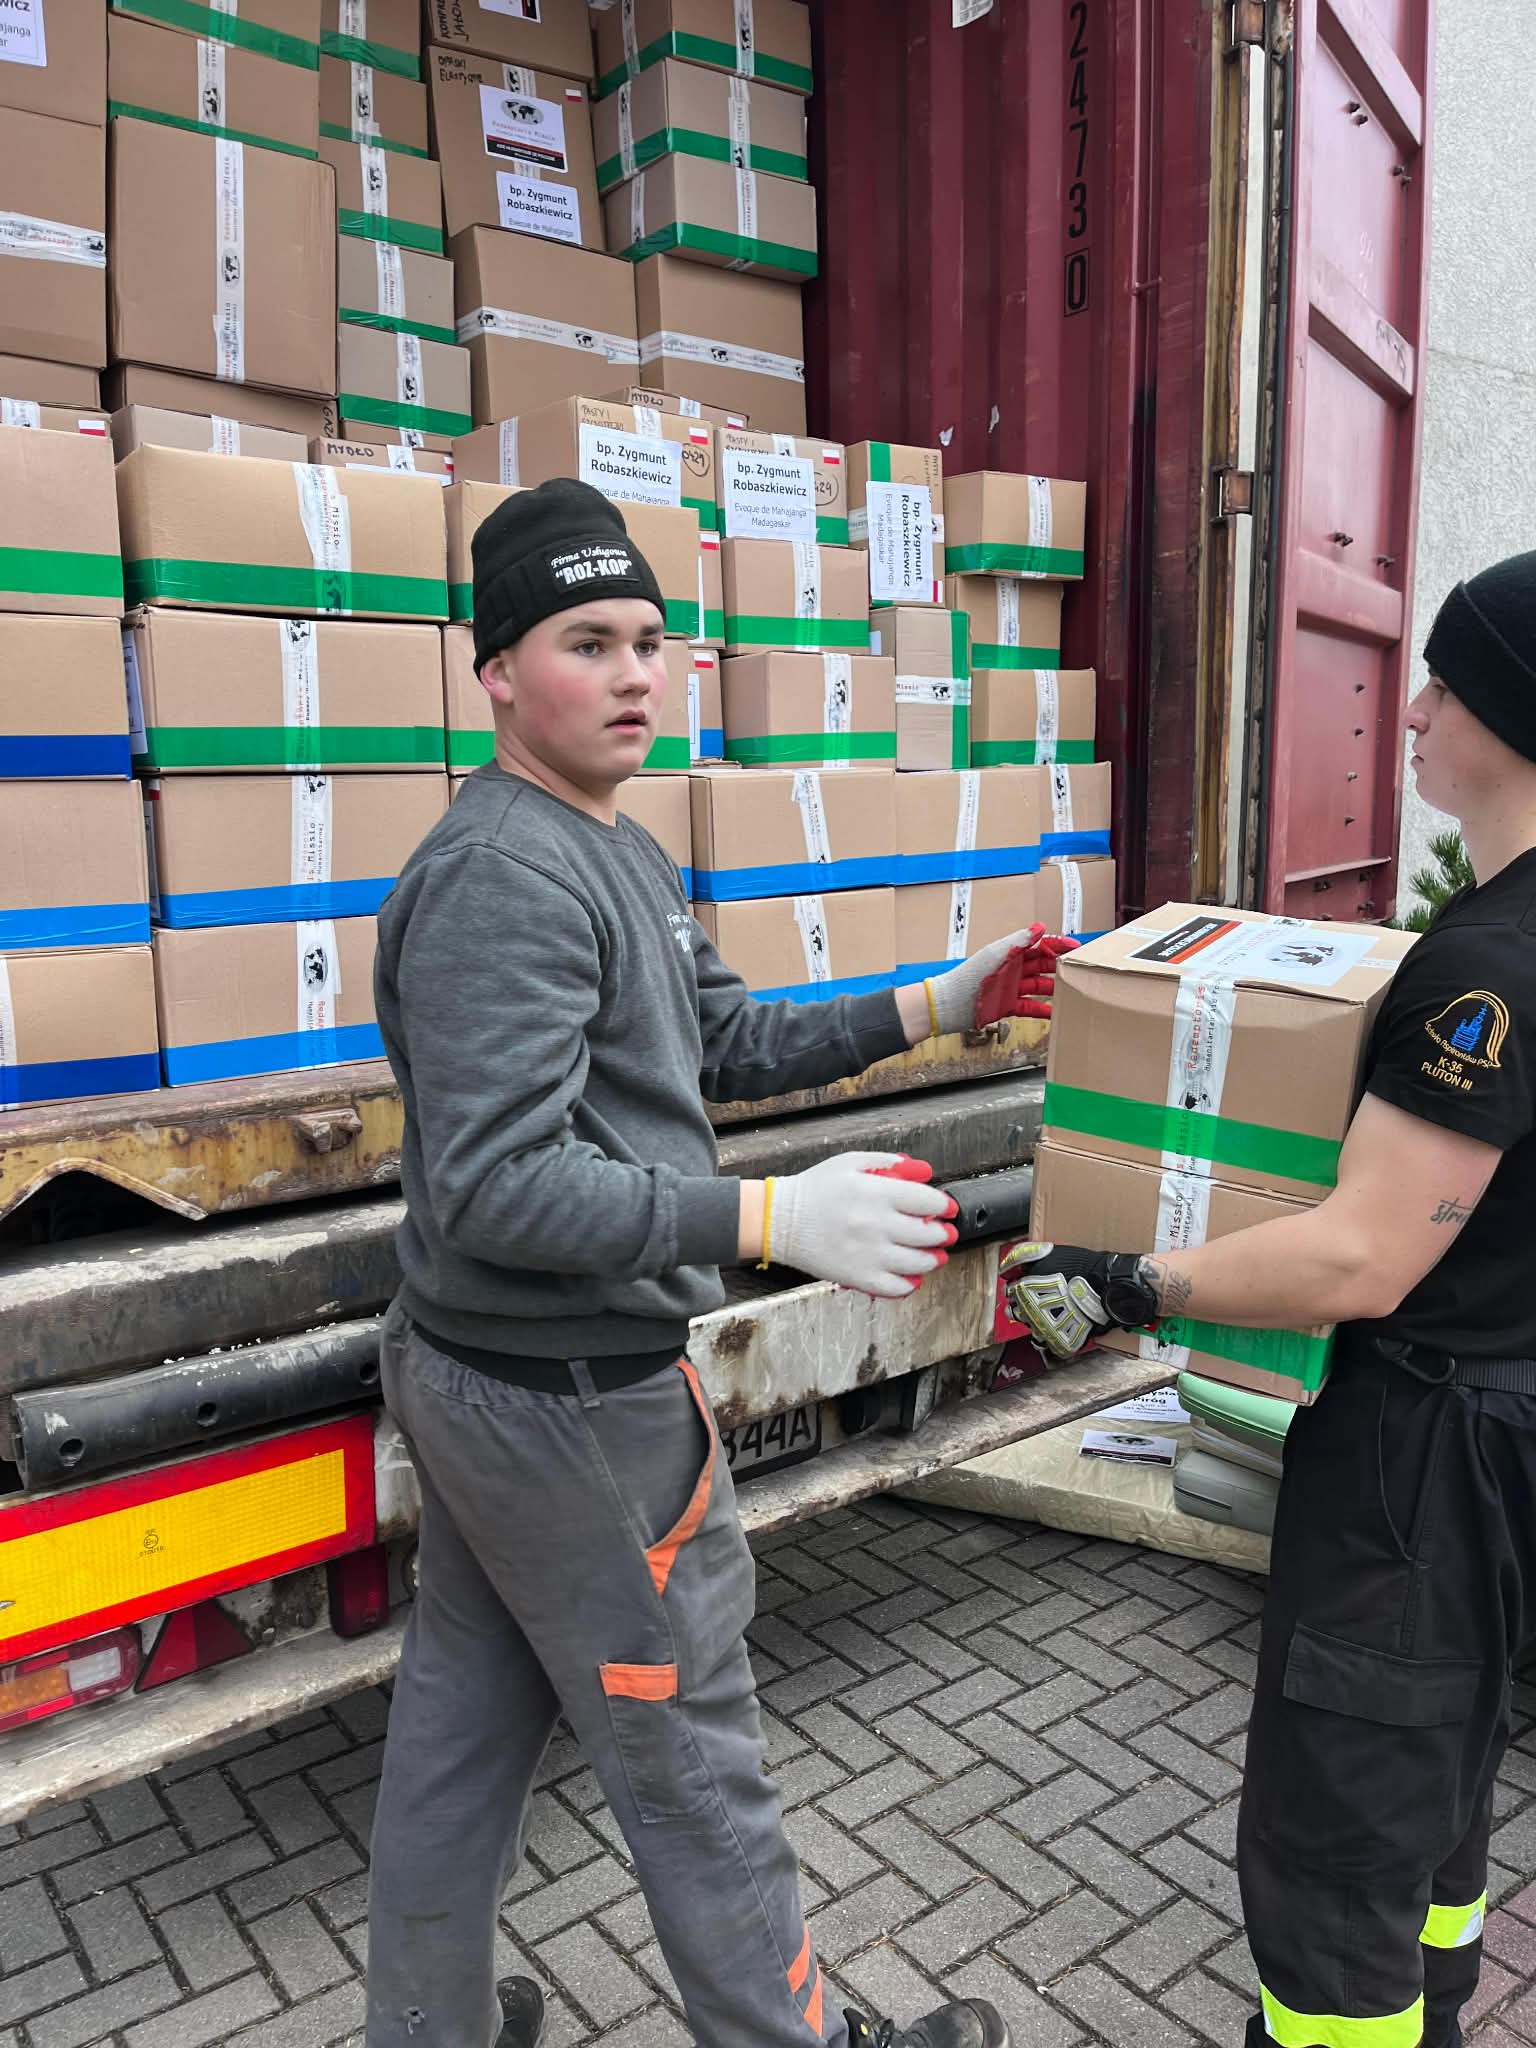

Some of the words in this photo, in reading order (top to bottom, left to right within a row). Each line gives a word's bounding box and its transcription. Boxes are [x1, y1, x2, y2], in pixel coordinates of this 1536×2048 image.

[509, 184, 526, 197] bp.
[527, 188, 567, 206] Zygmunt
[507, 198, 573, 220] Robaszkiewicz
[597, 441, 615, 457] bp.
[618, 445, 668, 466] Zygmunt
[591, 458, 672, 486] Robaszkiewicz
[737, 461, 754, 475] bp.
[756, 464, 801, 480] Zygmunt
[733, 479, 807, 497] Robaszkiewicz
[761, 504, 771, 514] de
[912, 501, 921, 521] bp.
[331, 506, 341, 546] Missio
[901, 494, 912, 588] Robaszkiewicz
[912, 524, 923, 582] Zygmunt
[551, 552, 580, 569] Firma
[580, 545, 628, 558] Usługowa
[307, 822, 316, 862] Missio
[1187, 985, 1206, 1071] Redemptoris
[1420, 1061, 1462, 1087] PLUTON
[1461, 1078, 1473, 1091] III
[1437, 1056, 1464, 1073] K-35
[1169, 1194, 1183, 1238] Missio
